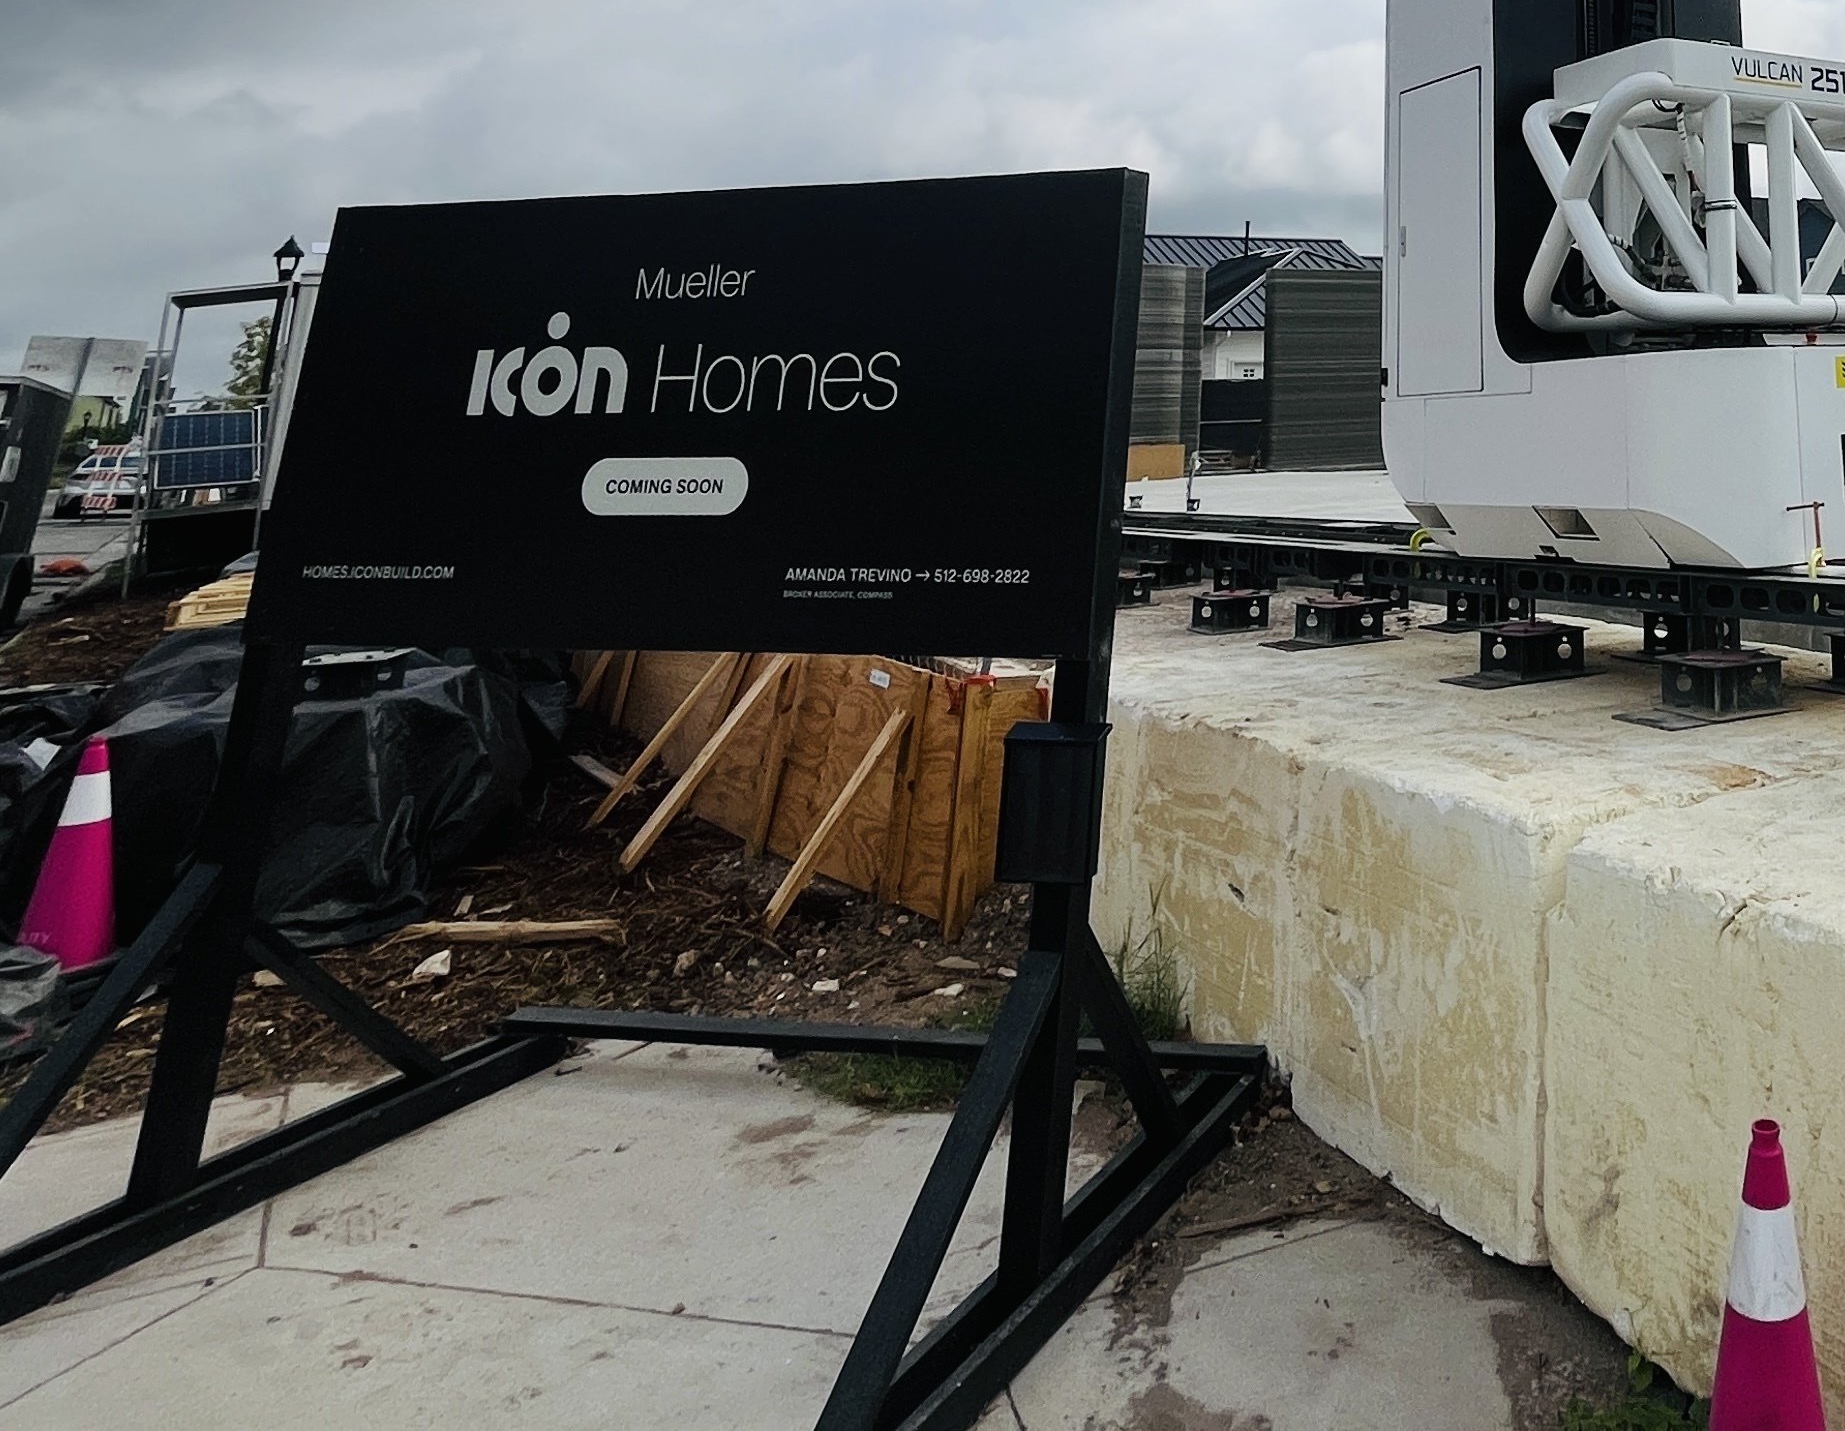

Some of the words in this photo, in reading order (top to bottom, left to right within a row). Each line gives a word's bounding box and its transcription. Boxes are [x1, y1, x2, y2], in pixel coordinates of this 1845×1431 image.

[1731, 56, 1803, 85] VULCAN
[635, 263, 756, 300] Mueller
[650, 343, 901, 414] Homes
[605, 478, 672, 495] COMING
[675, 478, 724, 495] SOON
[302, 564, 455, 580] HOMES.ICONBUILD.COM
[784, 567, 846, 582] AMANDA
[850, 567, 912, 583] TREVINO
[933, 568, 1030, 584] 512-698-2822
